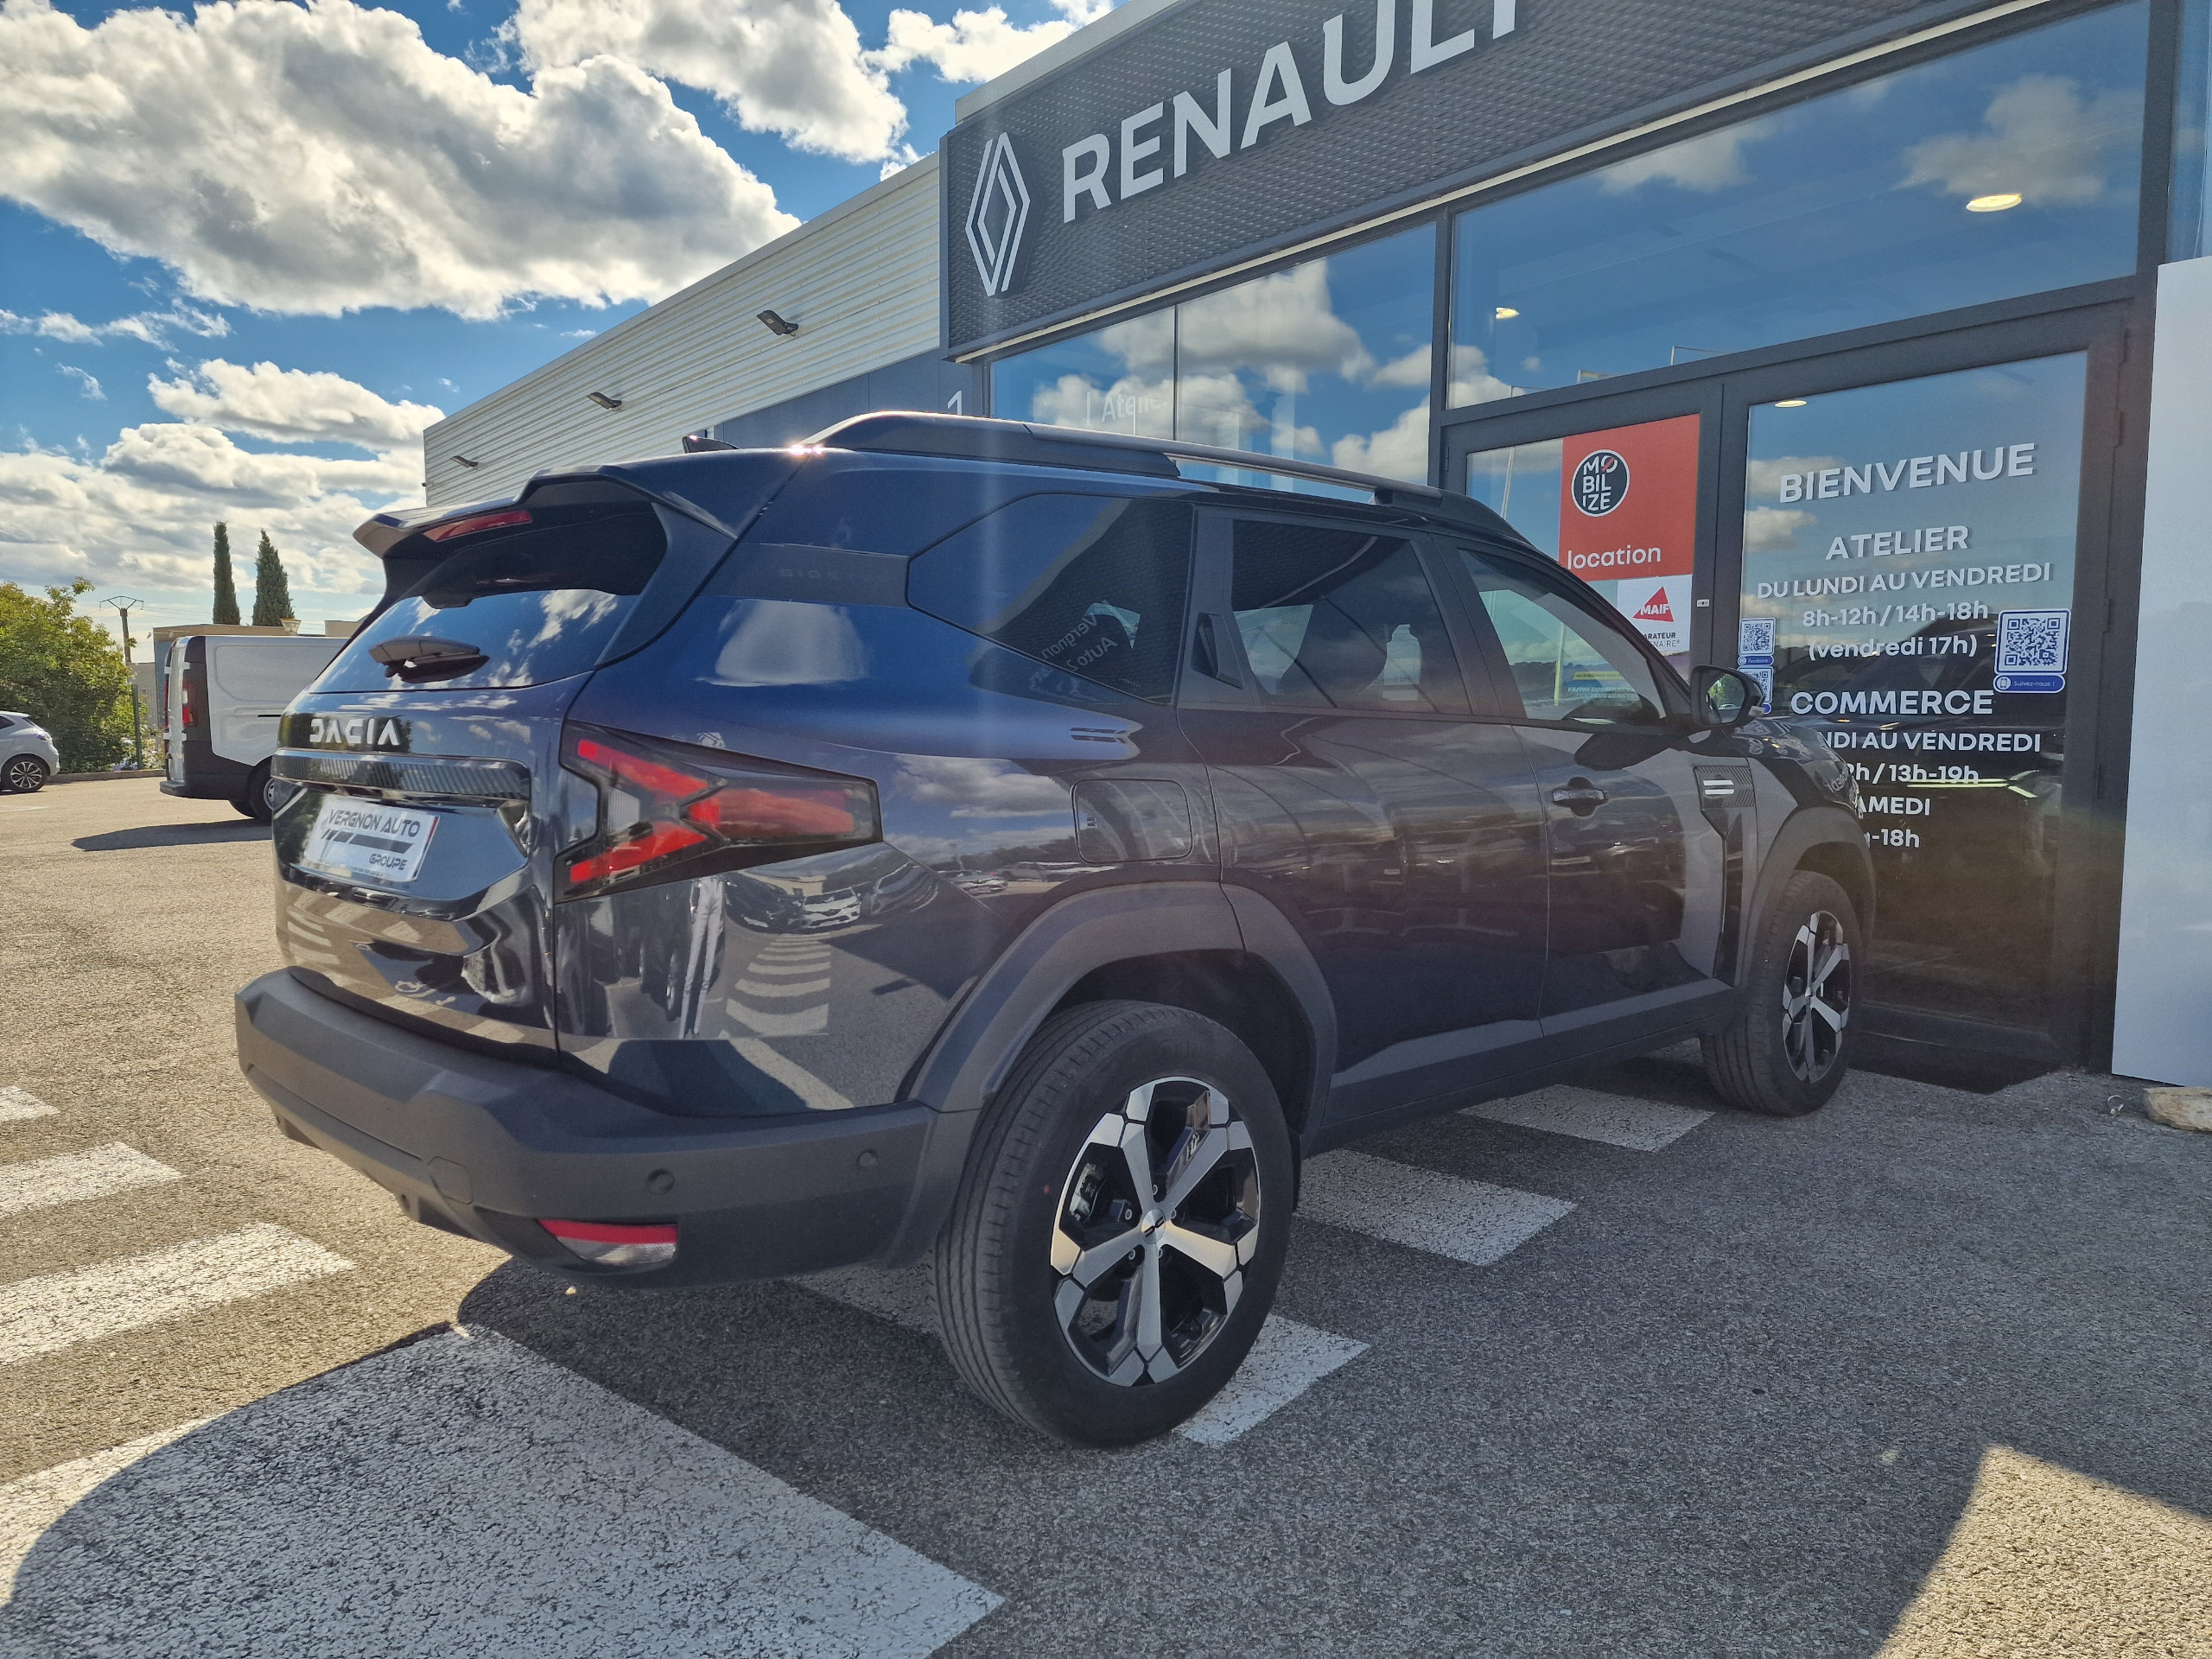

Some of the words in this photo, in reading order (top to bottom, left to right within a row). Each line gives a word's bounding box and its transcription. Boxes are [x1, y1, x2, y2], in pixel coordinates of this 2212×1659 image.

[1779, 442, 2035, 504] BIENVENUE
[1825, 525, 1969, 561] ATELIER
[1567, 544, 1662, 570] location
[1758, 581, 1789, 599] DU
[1793, 575, 1865, 597] LUNDI
[1869, 572, 1906, 592] AU
[1910, 563, 2050, 588] VENDREDI
[1640, 603, 1669, 616] MAIF
[1802, 606, 1877, 627] 8h-12h
[1897, 600, 1988, 622] 14h-18h
[1643, 632, 1676, 640] ARATEUR
[1808, 637, 1923, 661] (vendredi
[1928, 634, 1978, 658] 17h)
[1790, 690, 1993, 715] COMMERCE
[308, 718, 401, 747] DACIA
[1861, 732, 1897, 749] AU
[1903, 732, 2042, 753] VENDREDI
[1889, 763, 1980, 785] 13h-19h
[1858, 795, 1930, 817] AMEDI
[328, 809, 382, 831] VERGNON
[381, 817, 421, 838] AUTO
[368, 852, 408, 871] GROUPE
